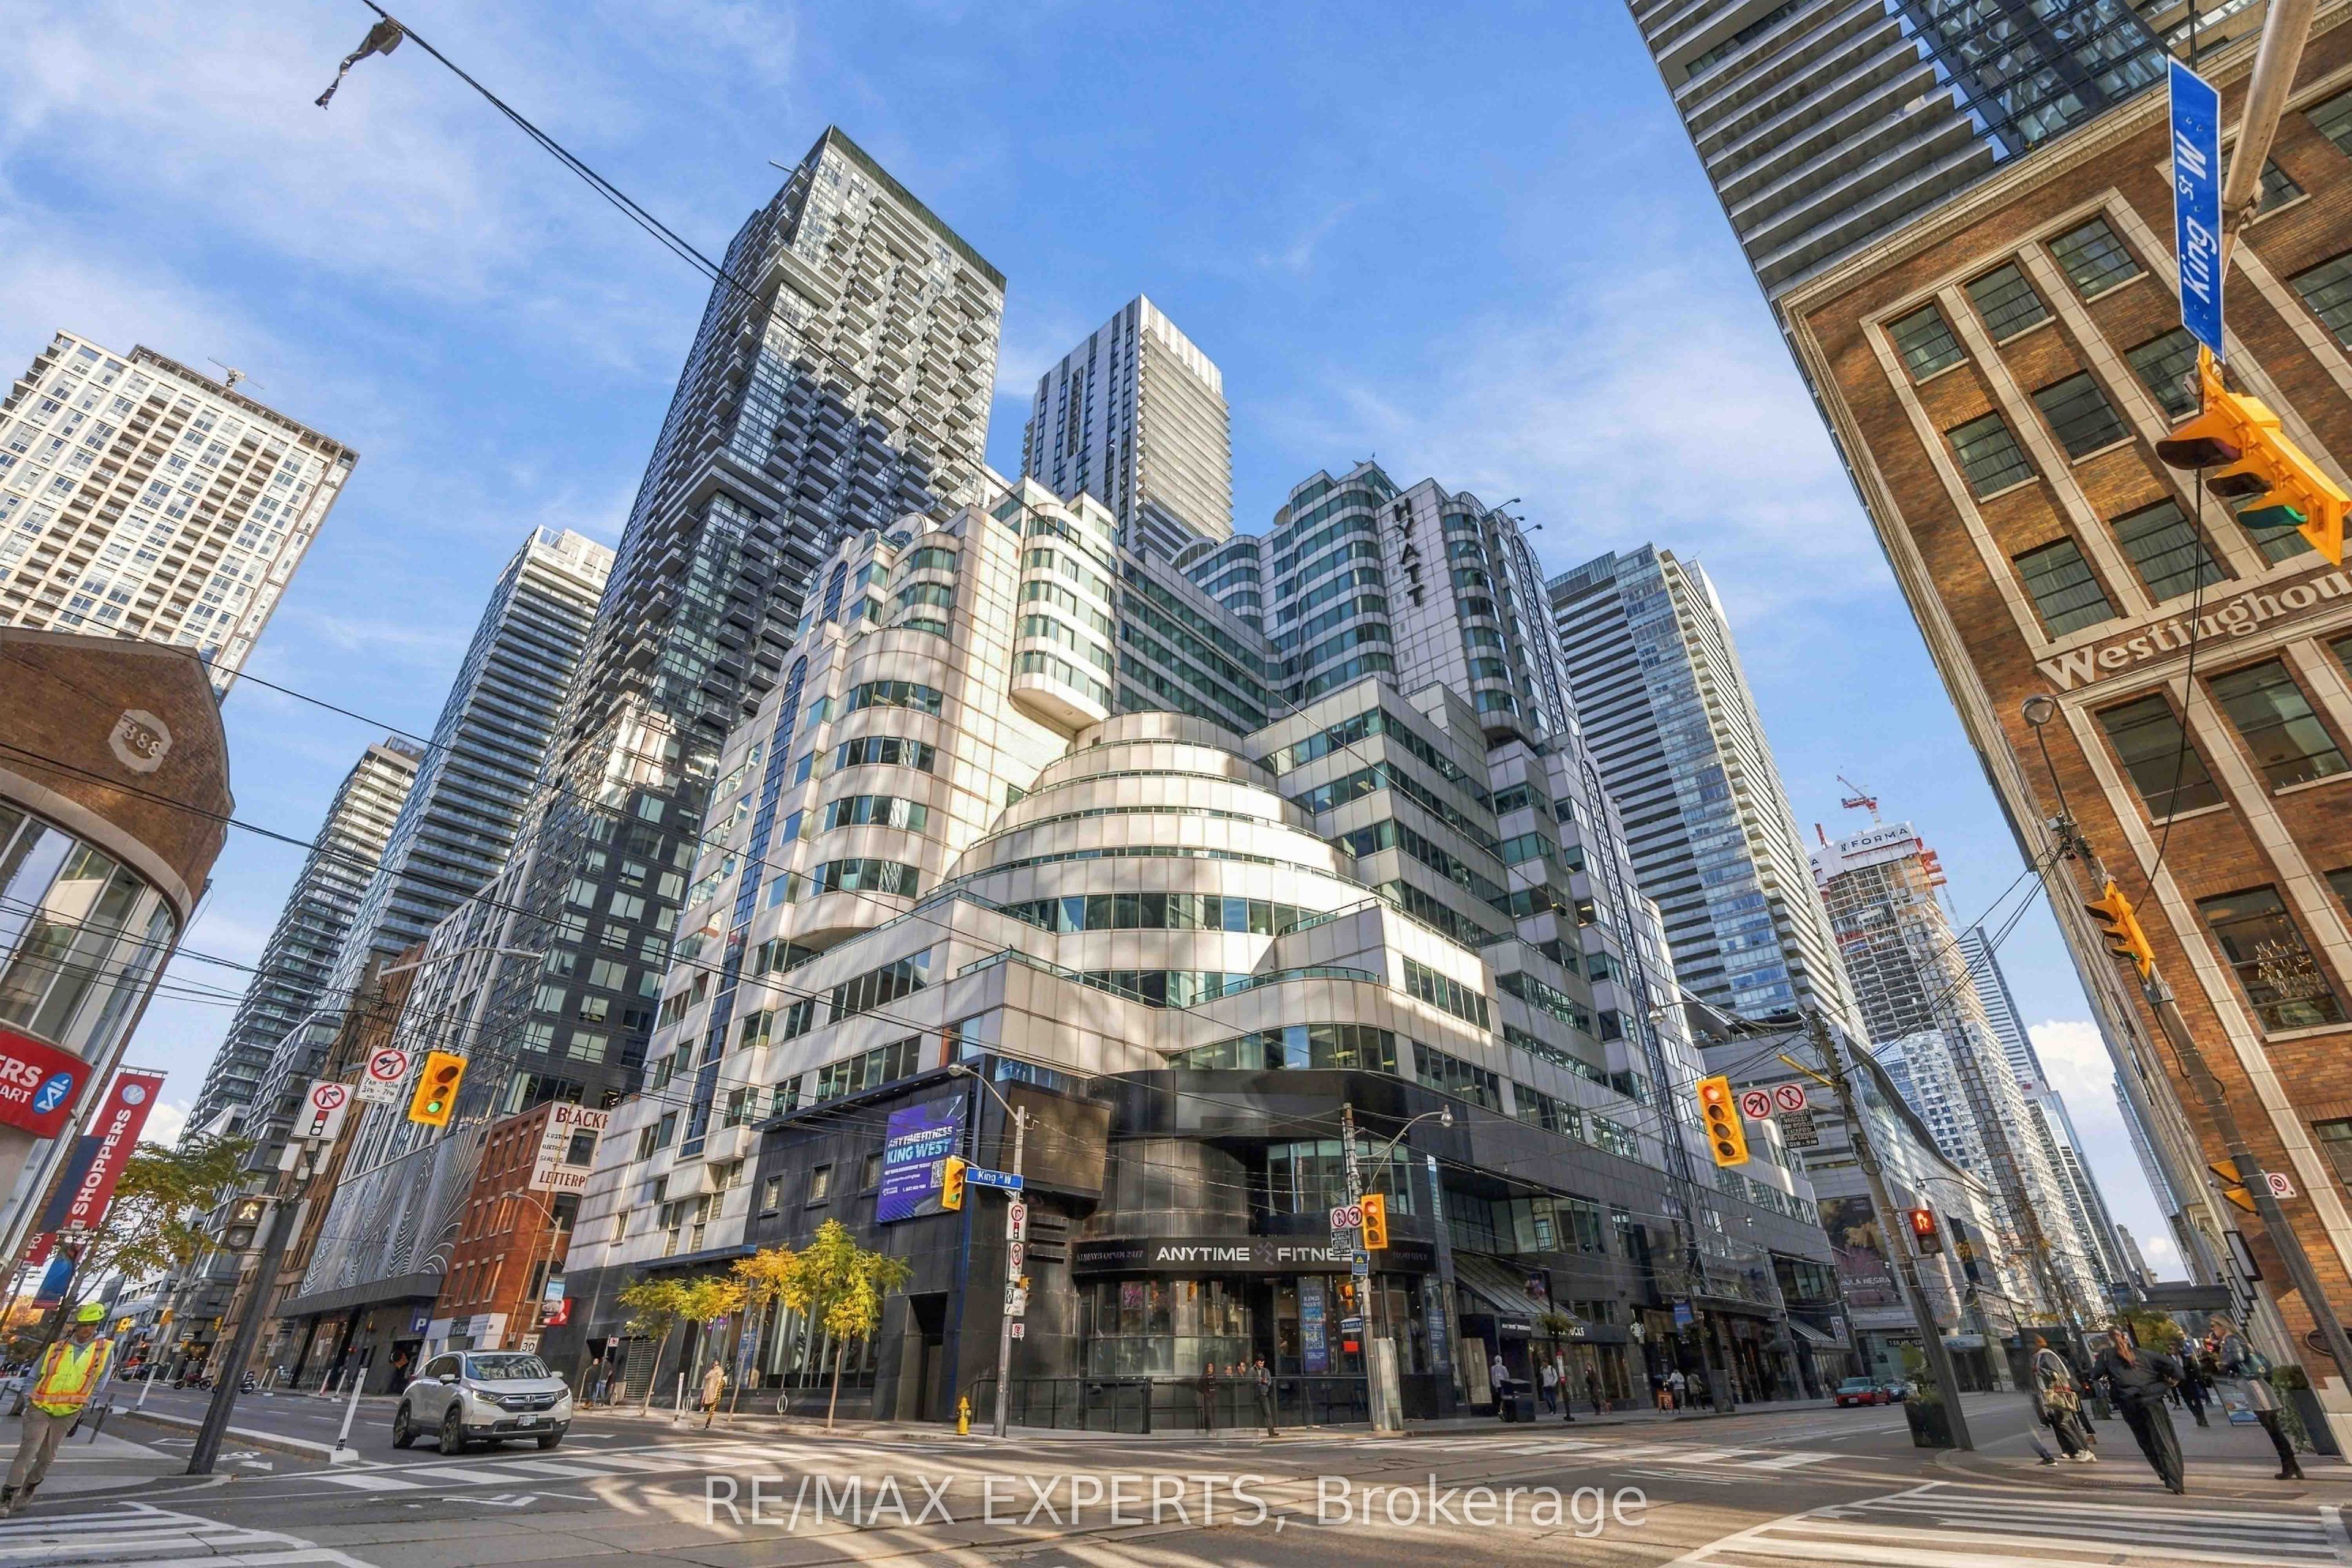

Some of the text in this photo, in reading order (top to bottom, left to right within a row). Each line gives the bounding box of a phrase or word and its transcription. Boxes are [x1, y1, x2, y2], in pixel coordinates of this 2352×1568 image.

[2176, 130, 2217, 304] King St W
[1393, 497, 1425, 607] HYATT
[2036, 570, 2352, 692] Westinghou
[121, 724, 161, 757] 388
[1851, 828, 1909, 848] FORMA
[0, 1082, 31, 1104] ART
[72, 1109, 132, 1217] SHOPPERS
[886, 1138, 952, 1164] KING WEST
[978, 1170, 996, 1185] King
[1005, 1174, 1012, 1185] W
[1156, 1246, 1250, 1262] ANYTIME
[415, 1317, 427, 1331] P
[521, 1342, 535, 1352] 30
